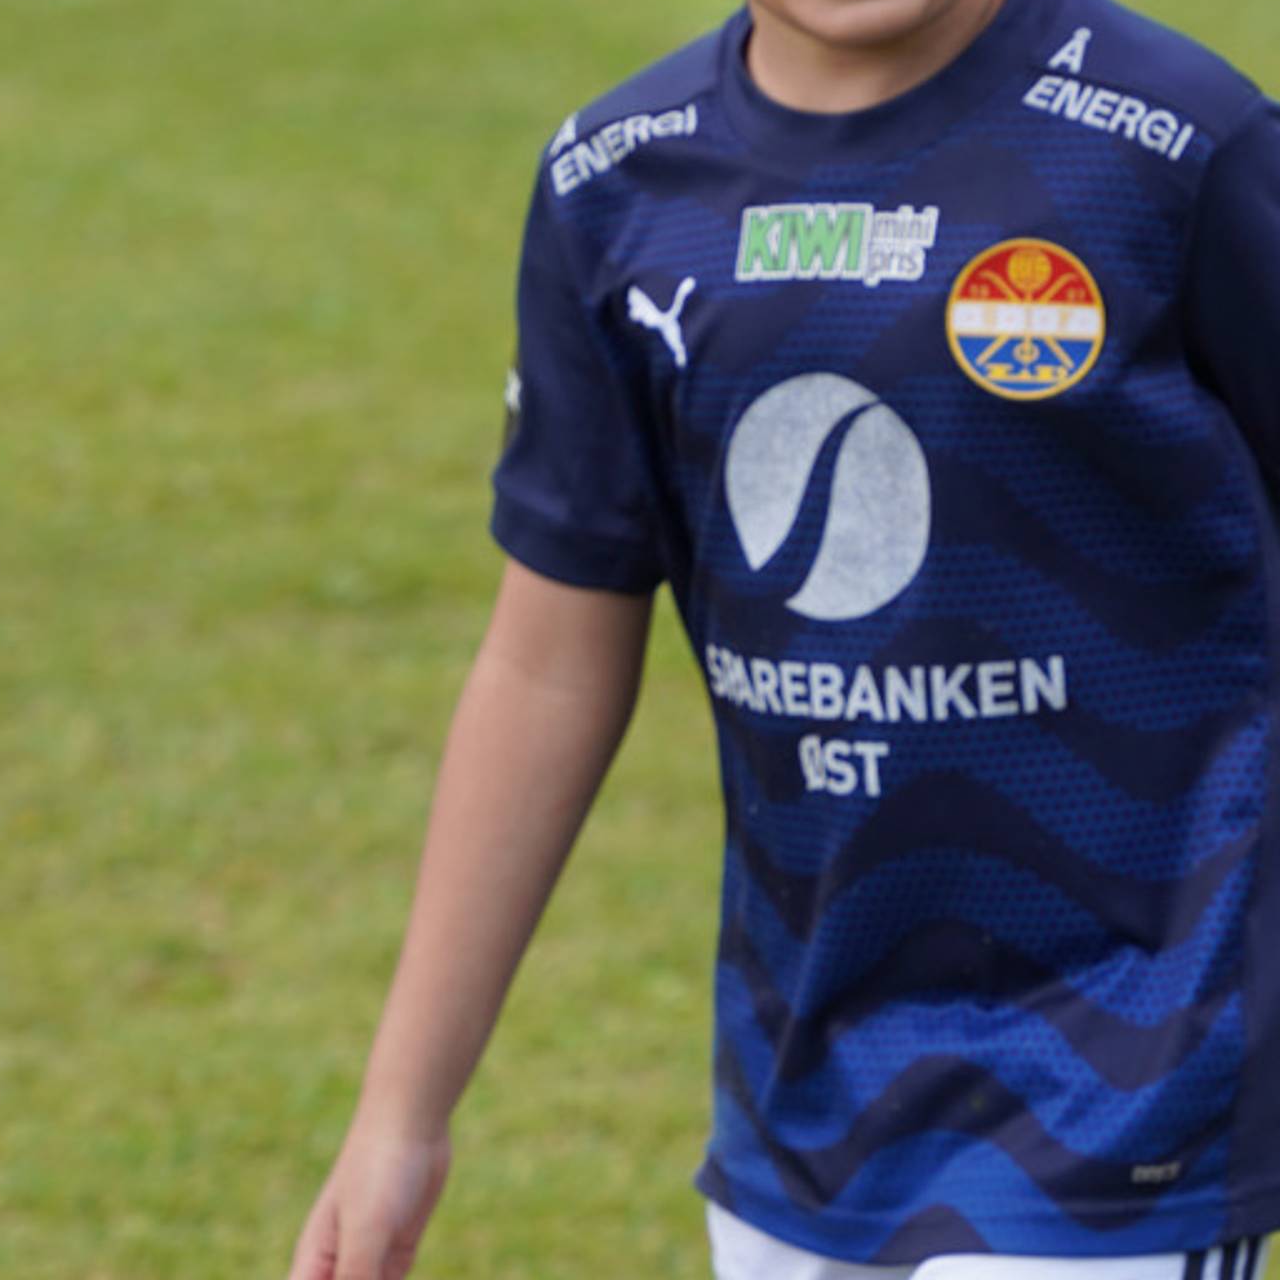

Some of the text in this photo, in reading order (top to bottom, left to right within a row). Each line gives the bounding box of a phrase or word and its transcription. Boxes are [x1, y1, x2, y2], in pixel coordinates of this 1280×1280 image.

[1048, 26, 1092, 74] Å
[551, 103, 698, 197] ENERGI
[1022, 74, 1195, 161] ENERGI
[738, 206, 869, 277] KIWI
[871, 207, 935, 243] mini
[706, 643, 1066, 722] SPAREBANKEN
[799, 734, 889, 797] ØST
